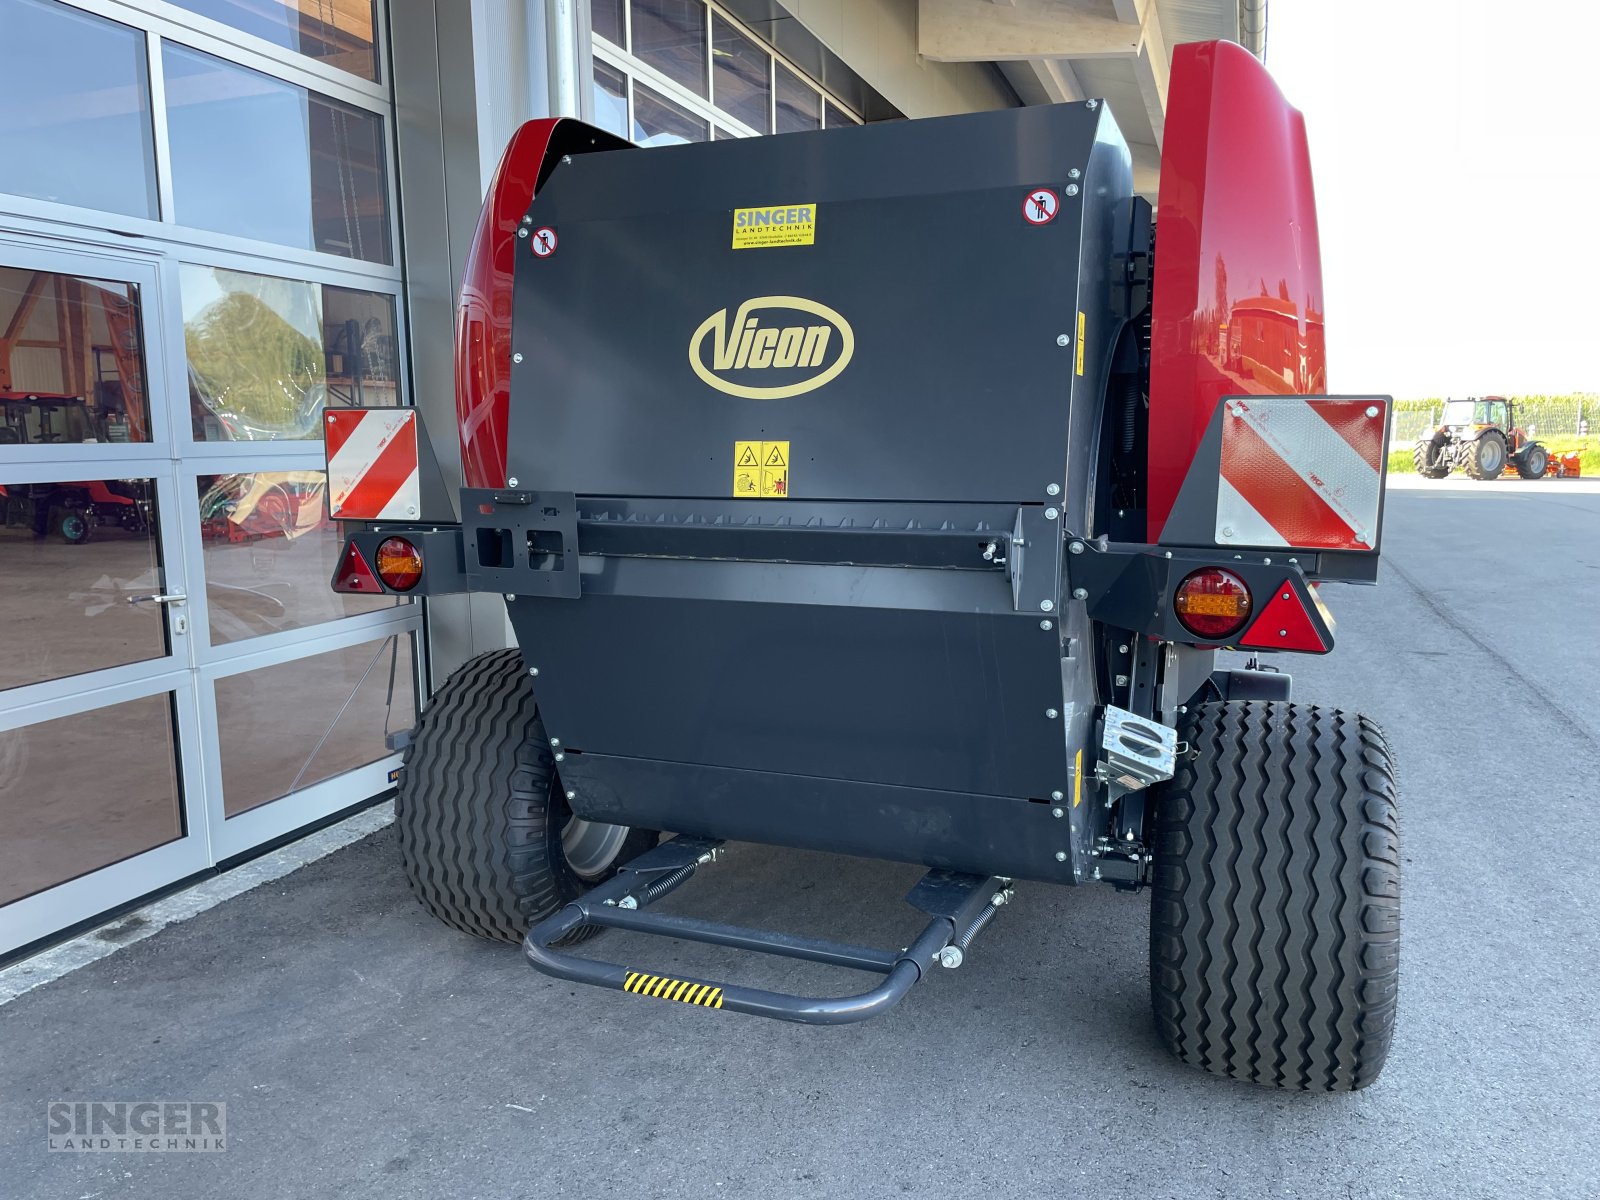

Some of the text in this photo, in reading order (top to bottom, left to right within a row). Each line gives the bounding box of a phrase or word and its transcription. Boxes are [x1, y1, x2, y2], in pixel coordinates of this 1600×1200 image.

[737, 208, 812, 227] SINGER
[735, 224, 813, 234] LANDTECHNIK
[713, 303, 832, 371] Vicon
